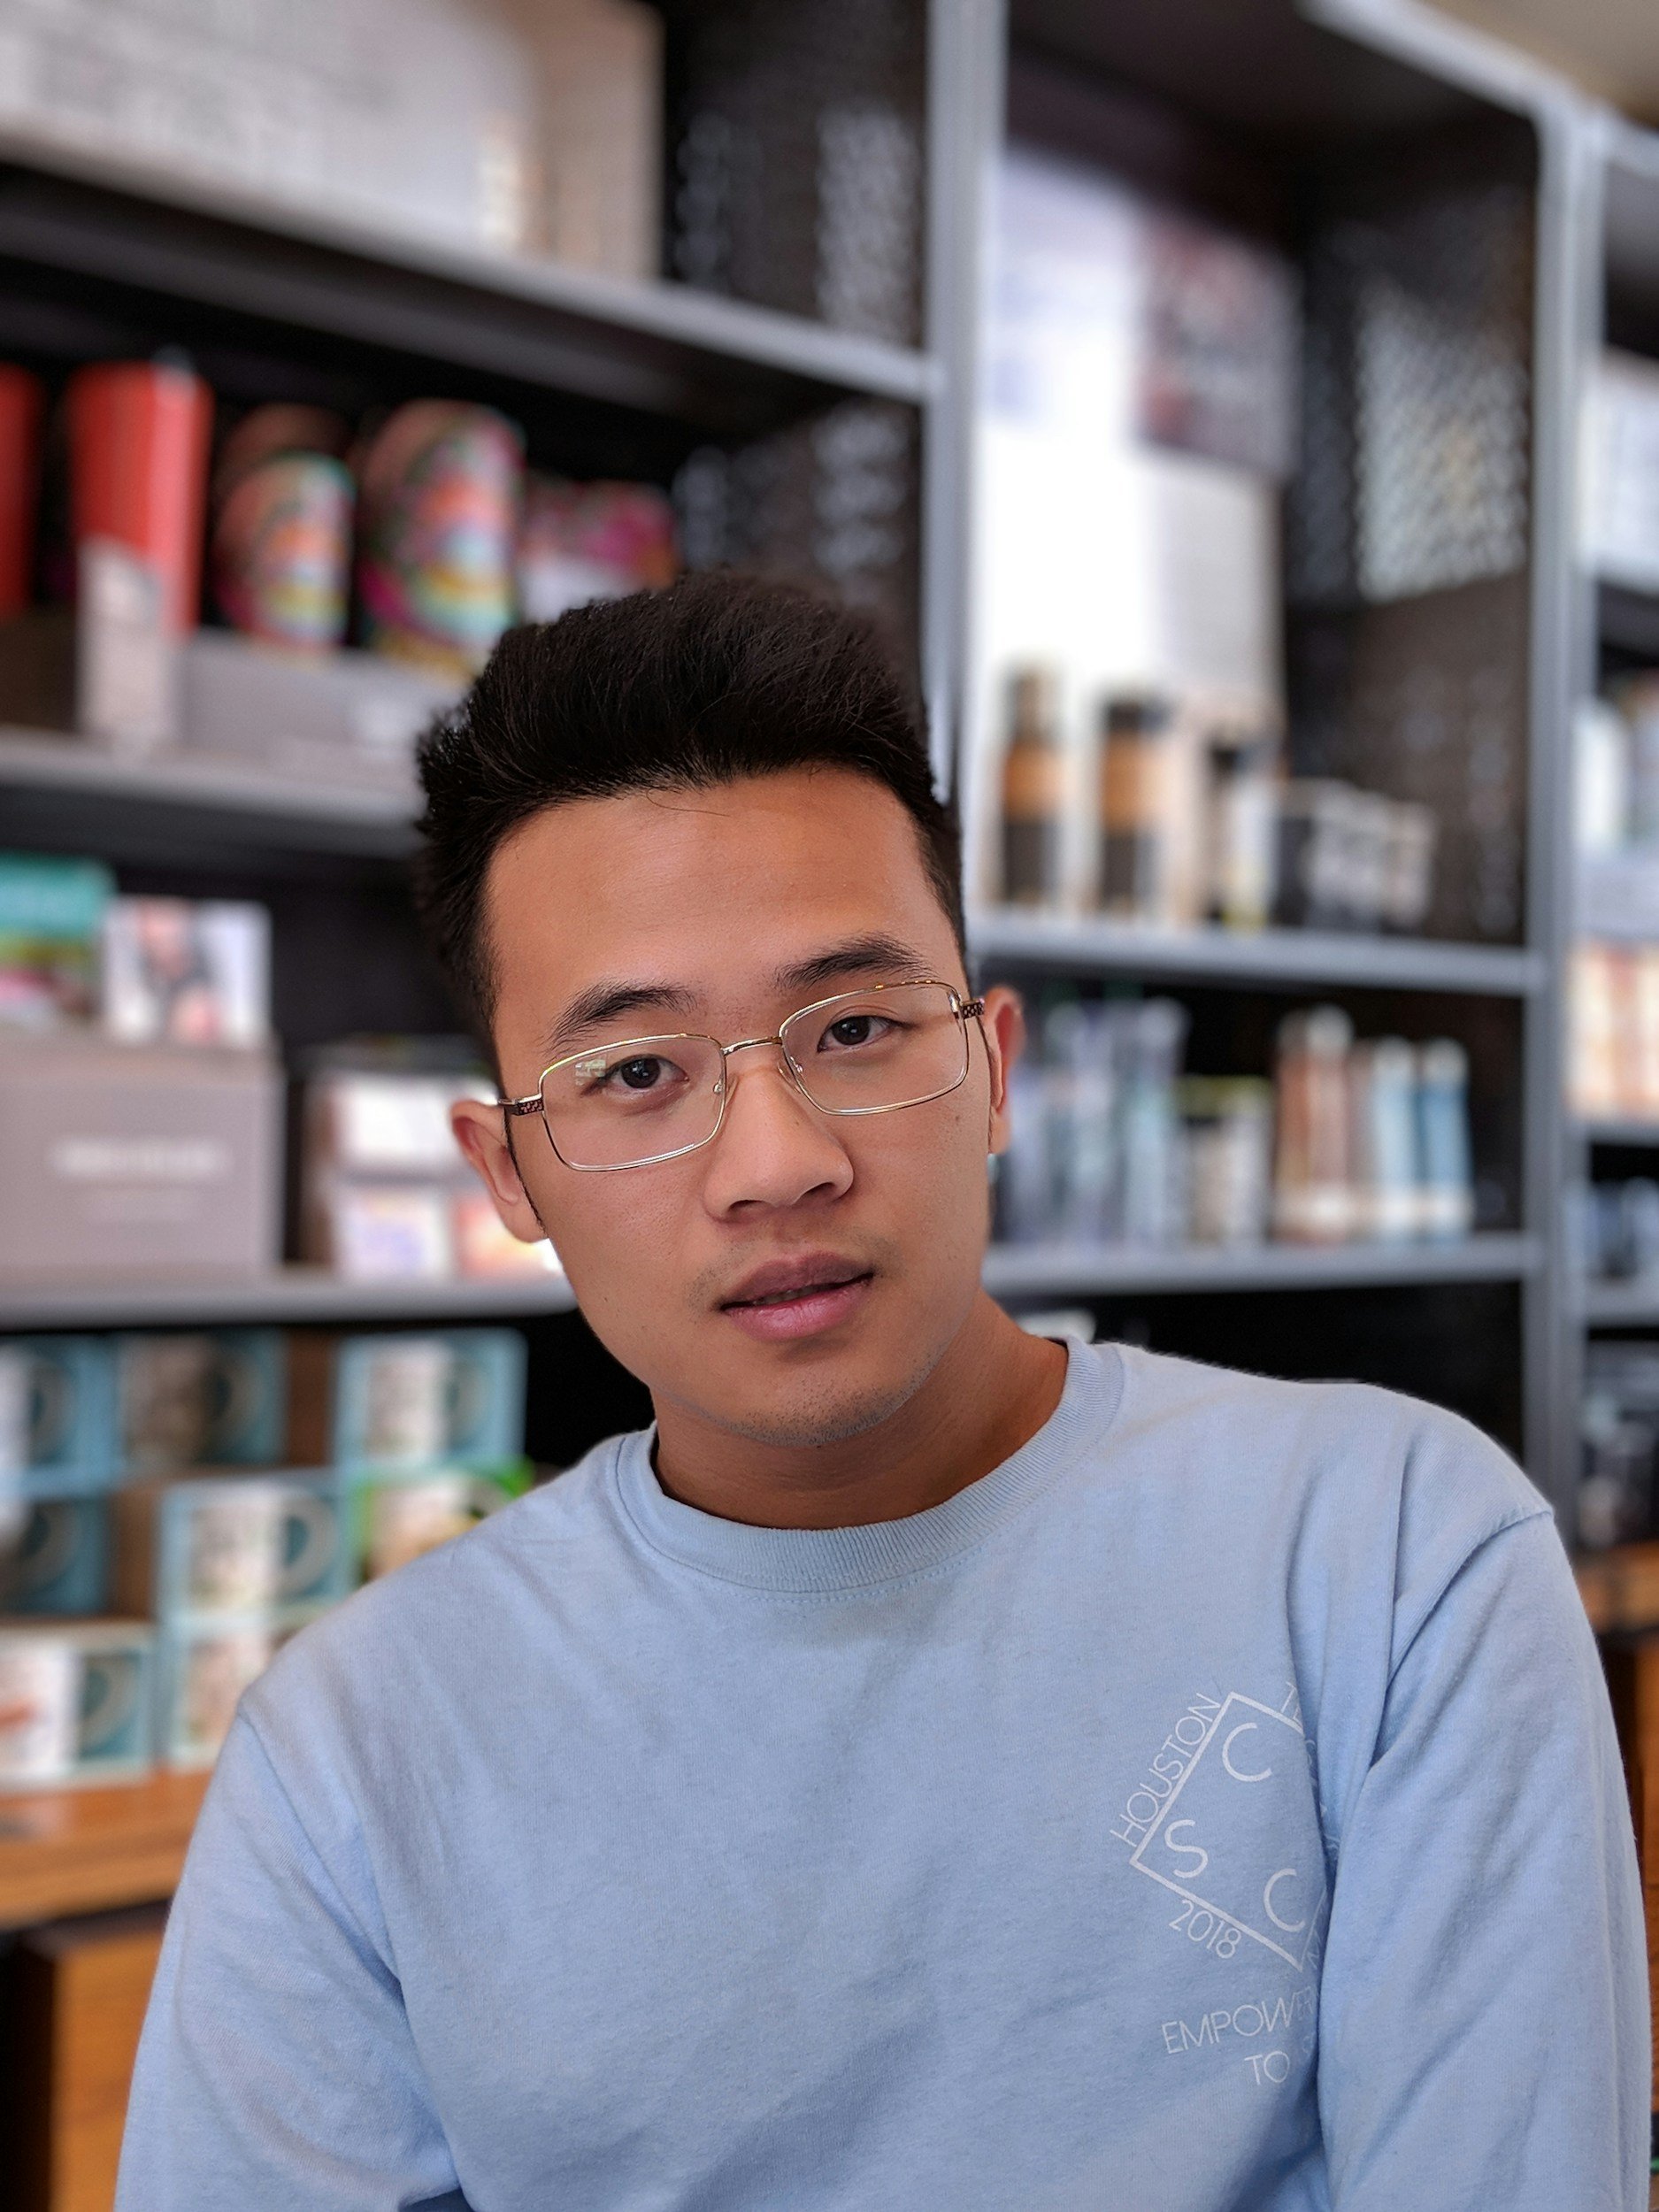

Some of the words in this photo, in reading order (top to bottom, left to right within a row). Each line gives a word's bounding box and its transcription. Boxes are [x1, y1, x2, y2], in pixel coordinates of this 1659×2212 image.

[1110, 1692, 1221, 1848] HOUSTON
[1221, 1722, 1273, 1783] C
[1164, 1818, 1210, 1879] S
[1168, 1899, 1242, 1959] 2018
[1263, 1868, 1306, 1933] C
[1243, 2050, 1290, 2085] TO
